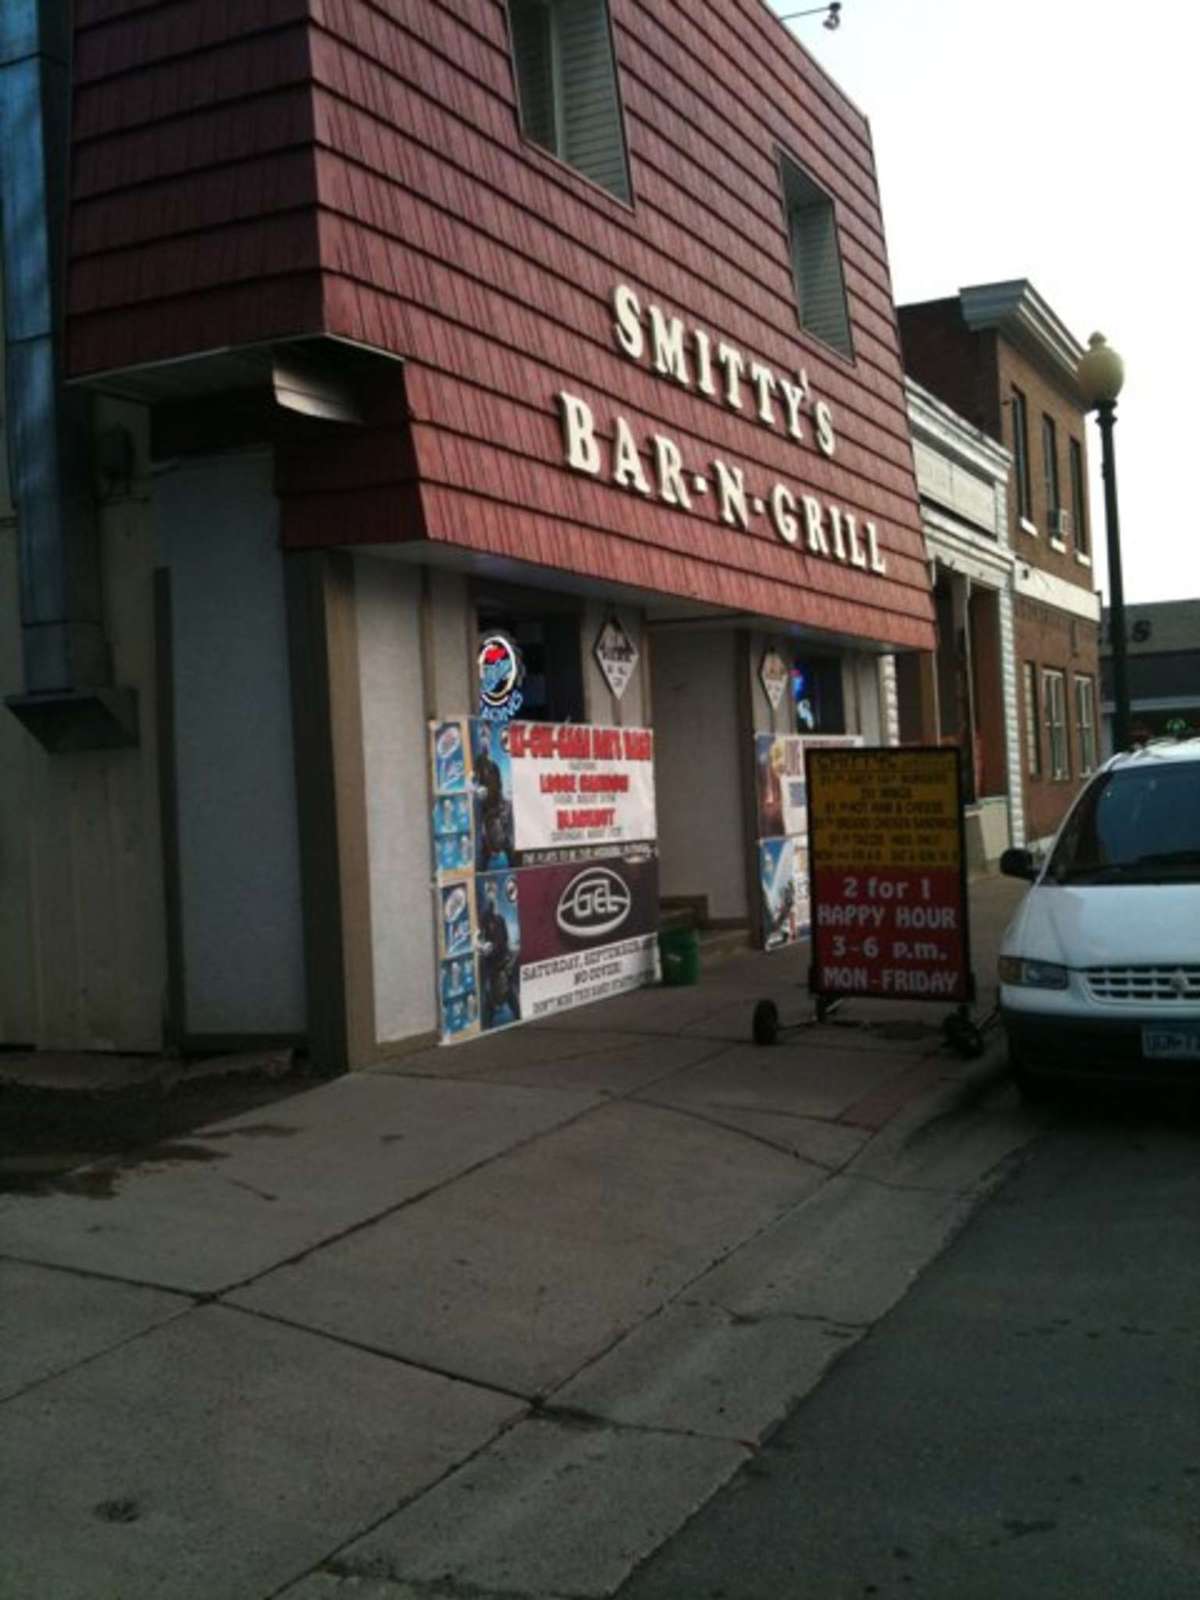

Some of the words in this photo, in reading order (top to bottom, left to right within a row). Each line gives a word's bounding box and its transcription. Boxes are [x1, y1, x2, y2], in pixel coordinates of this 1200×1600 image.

[614, 284, 835, 456] SMITTY'S
[560, 391, 886, 575] BAR-N-GRILL
[817, 904, 885, 927] HAPPY
[895, 906, 957, 928] HOUR
[843, 876, 858, 898] 2
[868, 876, 909, 899] for
[921, 877, 931, 900] 1
